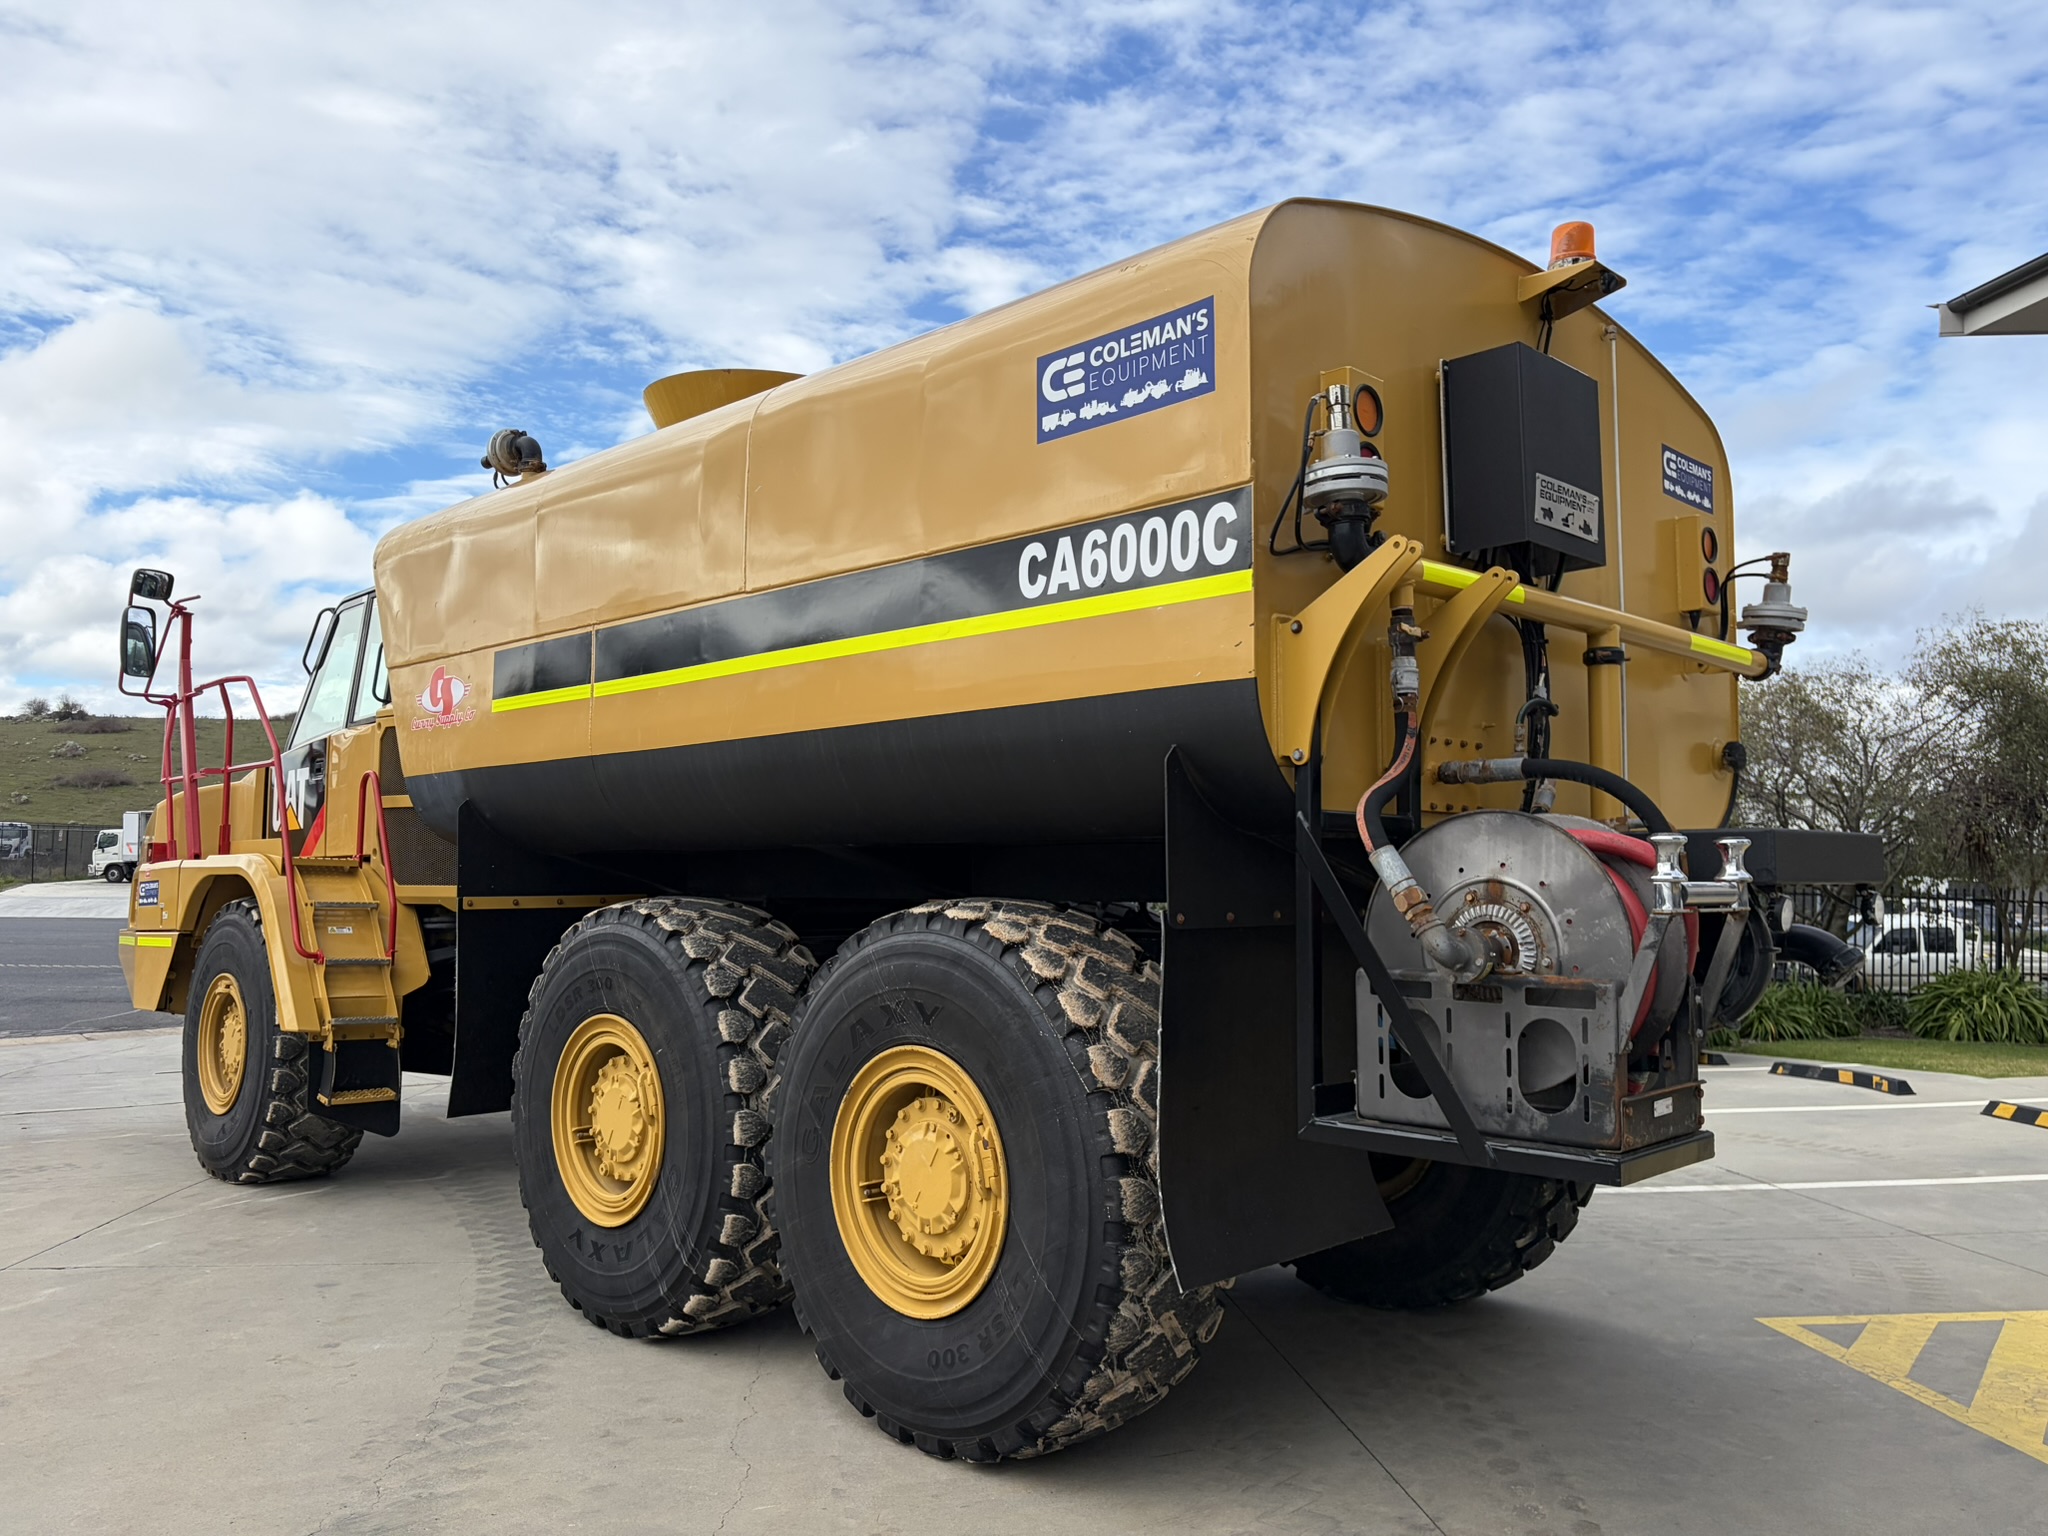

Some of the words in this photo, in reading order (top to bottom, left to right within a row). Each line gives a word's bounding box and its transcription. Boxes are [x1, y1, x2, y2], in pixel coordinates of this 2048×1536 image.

[1089, 308, 1209, 367] COLEMAN'S
[1089, 334, 1209, 391] EQUIPMENT
[1677, 456, 1712, 482] COLEMAN'S
[1539, 489, 1587, 514] EQUIPMENT
[1540, 479, 1588, 504] COLEMAN'S
[1018, 501, 1239, 599] CA6000C
[270, 766, 310, 832] CAT
[586, 975, 614, 994] 300
[800, 997, 945, 1167] GALAXY
[926, 1343, 970, 1372] 300
